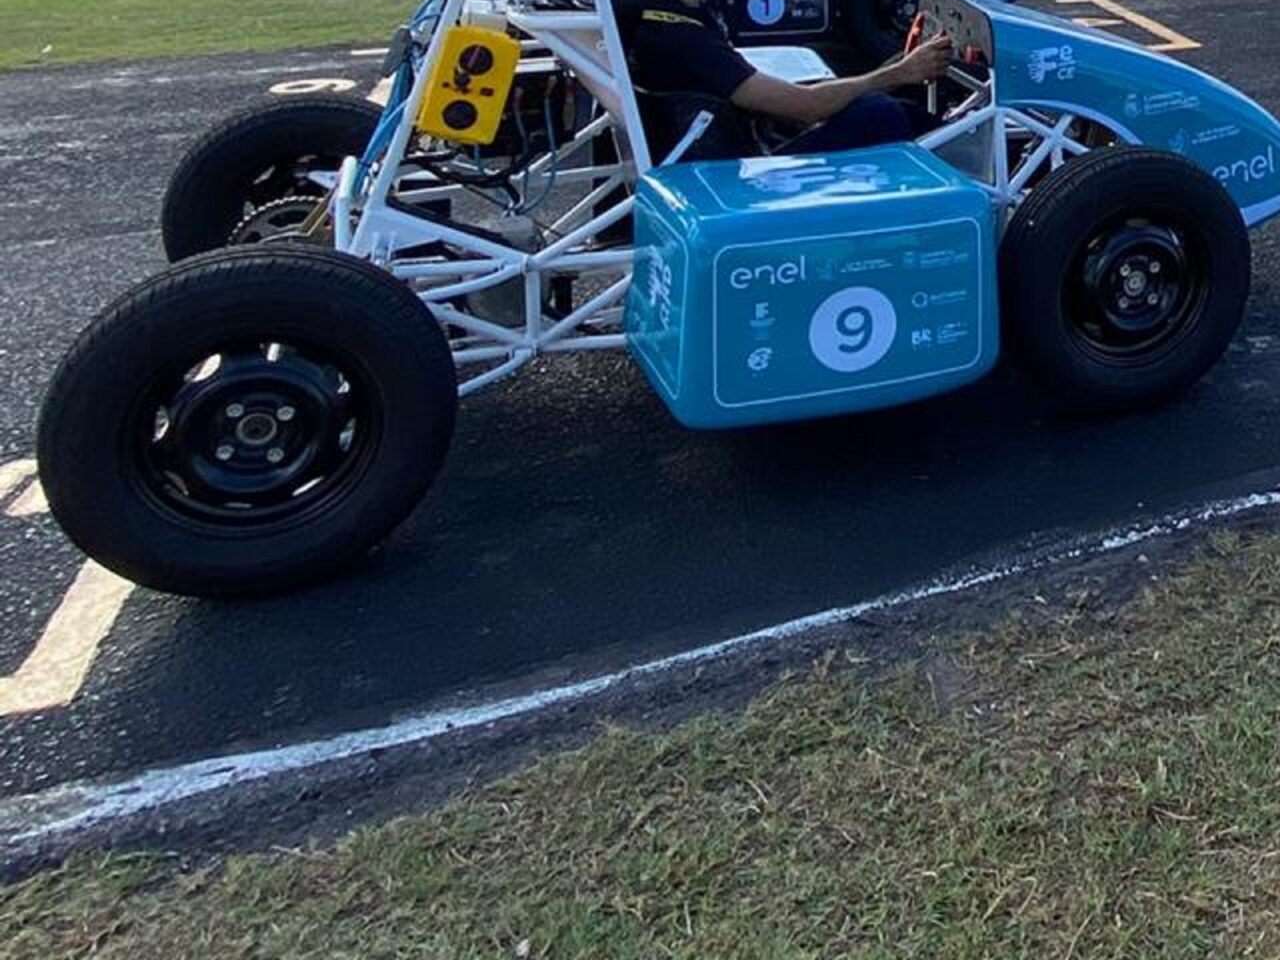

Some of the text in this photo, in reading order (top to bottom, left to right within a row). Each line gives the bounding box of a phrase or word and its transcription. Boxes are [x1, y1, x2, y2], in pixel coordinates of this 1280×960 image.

[1211, 144, 1275, 187] enel
[730, 255, 806, 290] enel
[835, 304, 874, 355] 9
